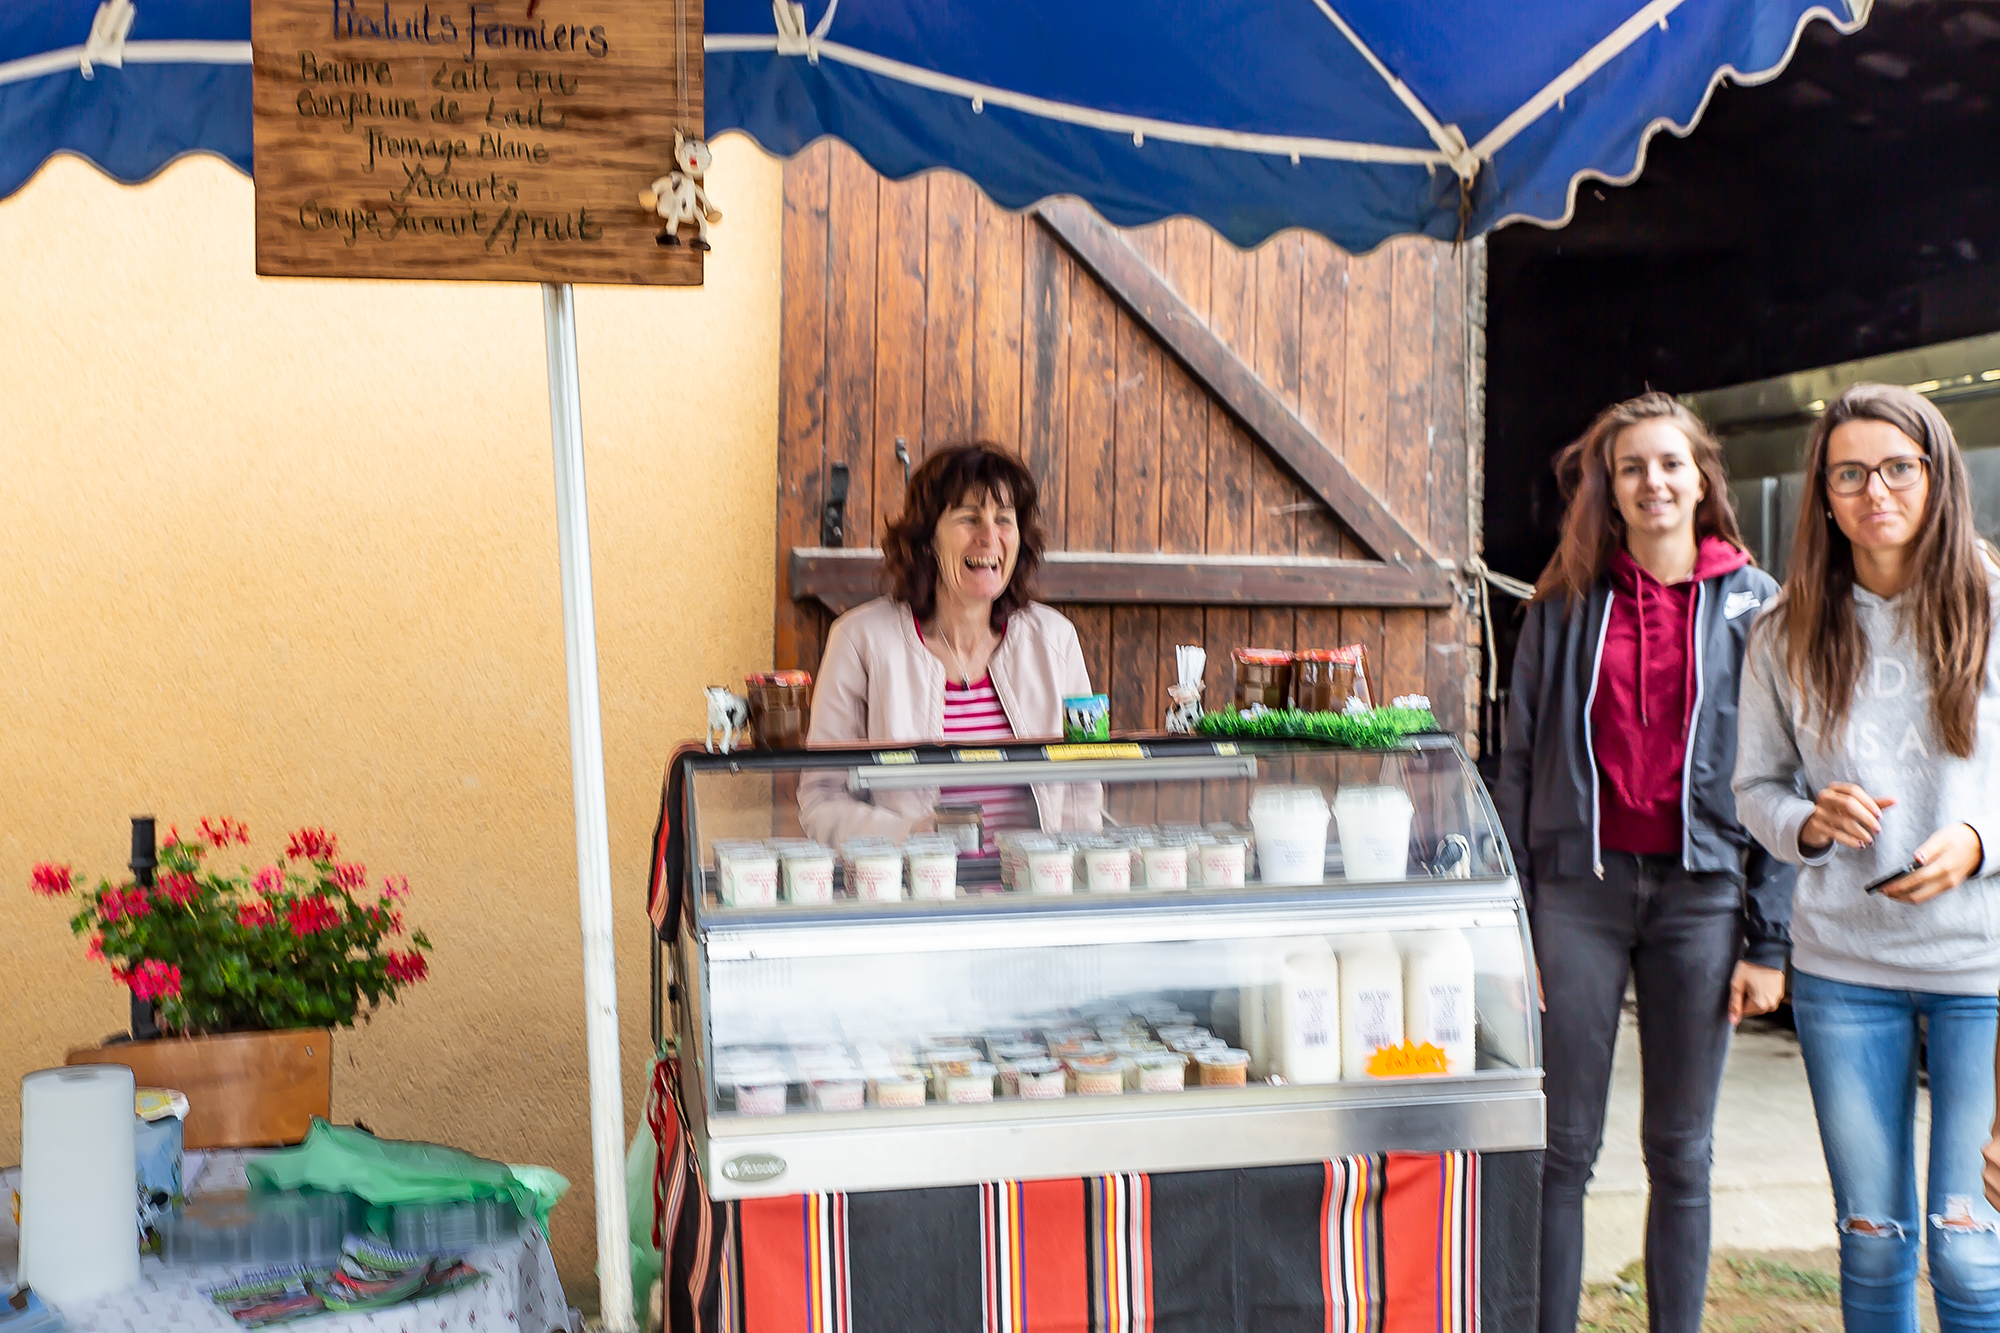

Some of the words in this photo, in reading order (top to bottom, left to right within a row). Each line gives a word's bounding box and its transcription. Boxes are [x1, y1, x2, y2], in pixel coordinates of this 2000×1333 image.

[298, 50, 394, 89] Beurre
[296, 89, 420, 133] Confiture
[430, 95, 465, 124] de
[299, 201, 379, 247] Coupe
[1896, 719, 1930, 761] A
